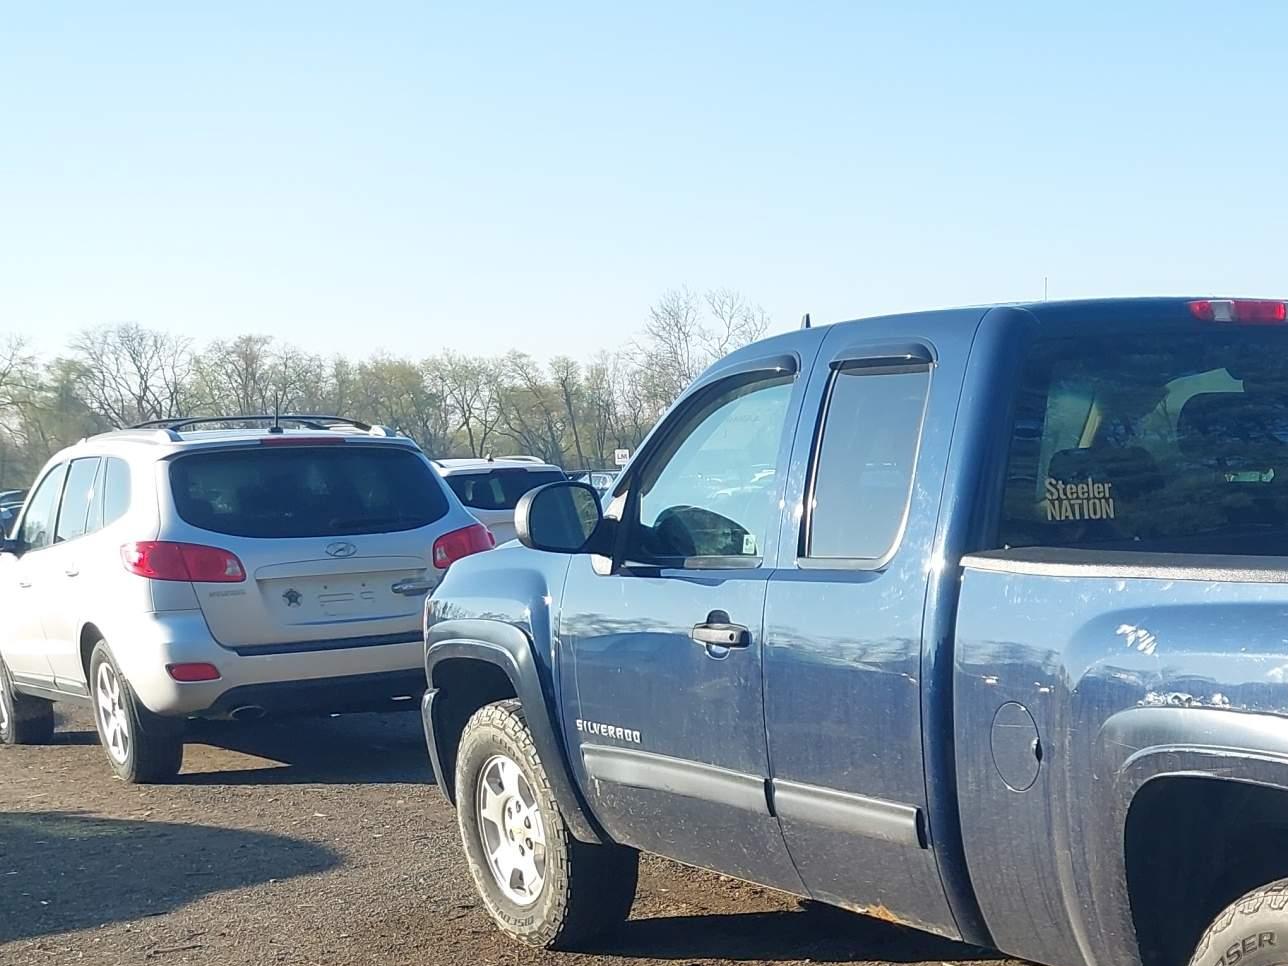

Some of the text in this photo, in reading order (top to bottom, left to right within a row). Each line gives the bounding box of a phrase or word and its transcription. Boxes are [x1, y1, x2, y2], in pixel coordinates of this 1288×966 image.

[1045, 476, 1112, 499] Steeler
[1047, 498, 1115, 520] NATION
[576, 719, 641, 743] SILVERADO
